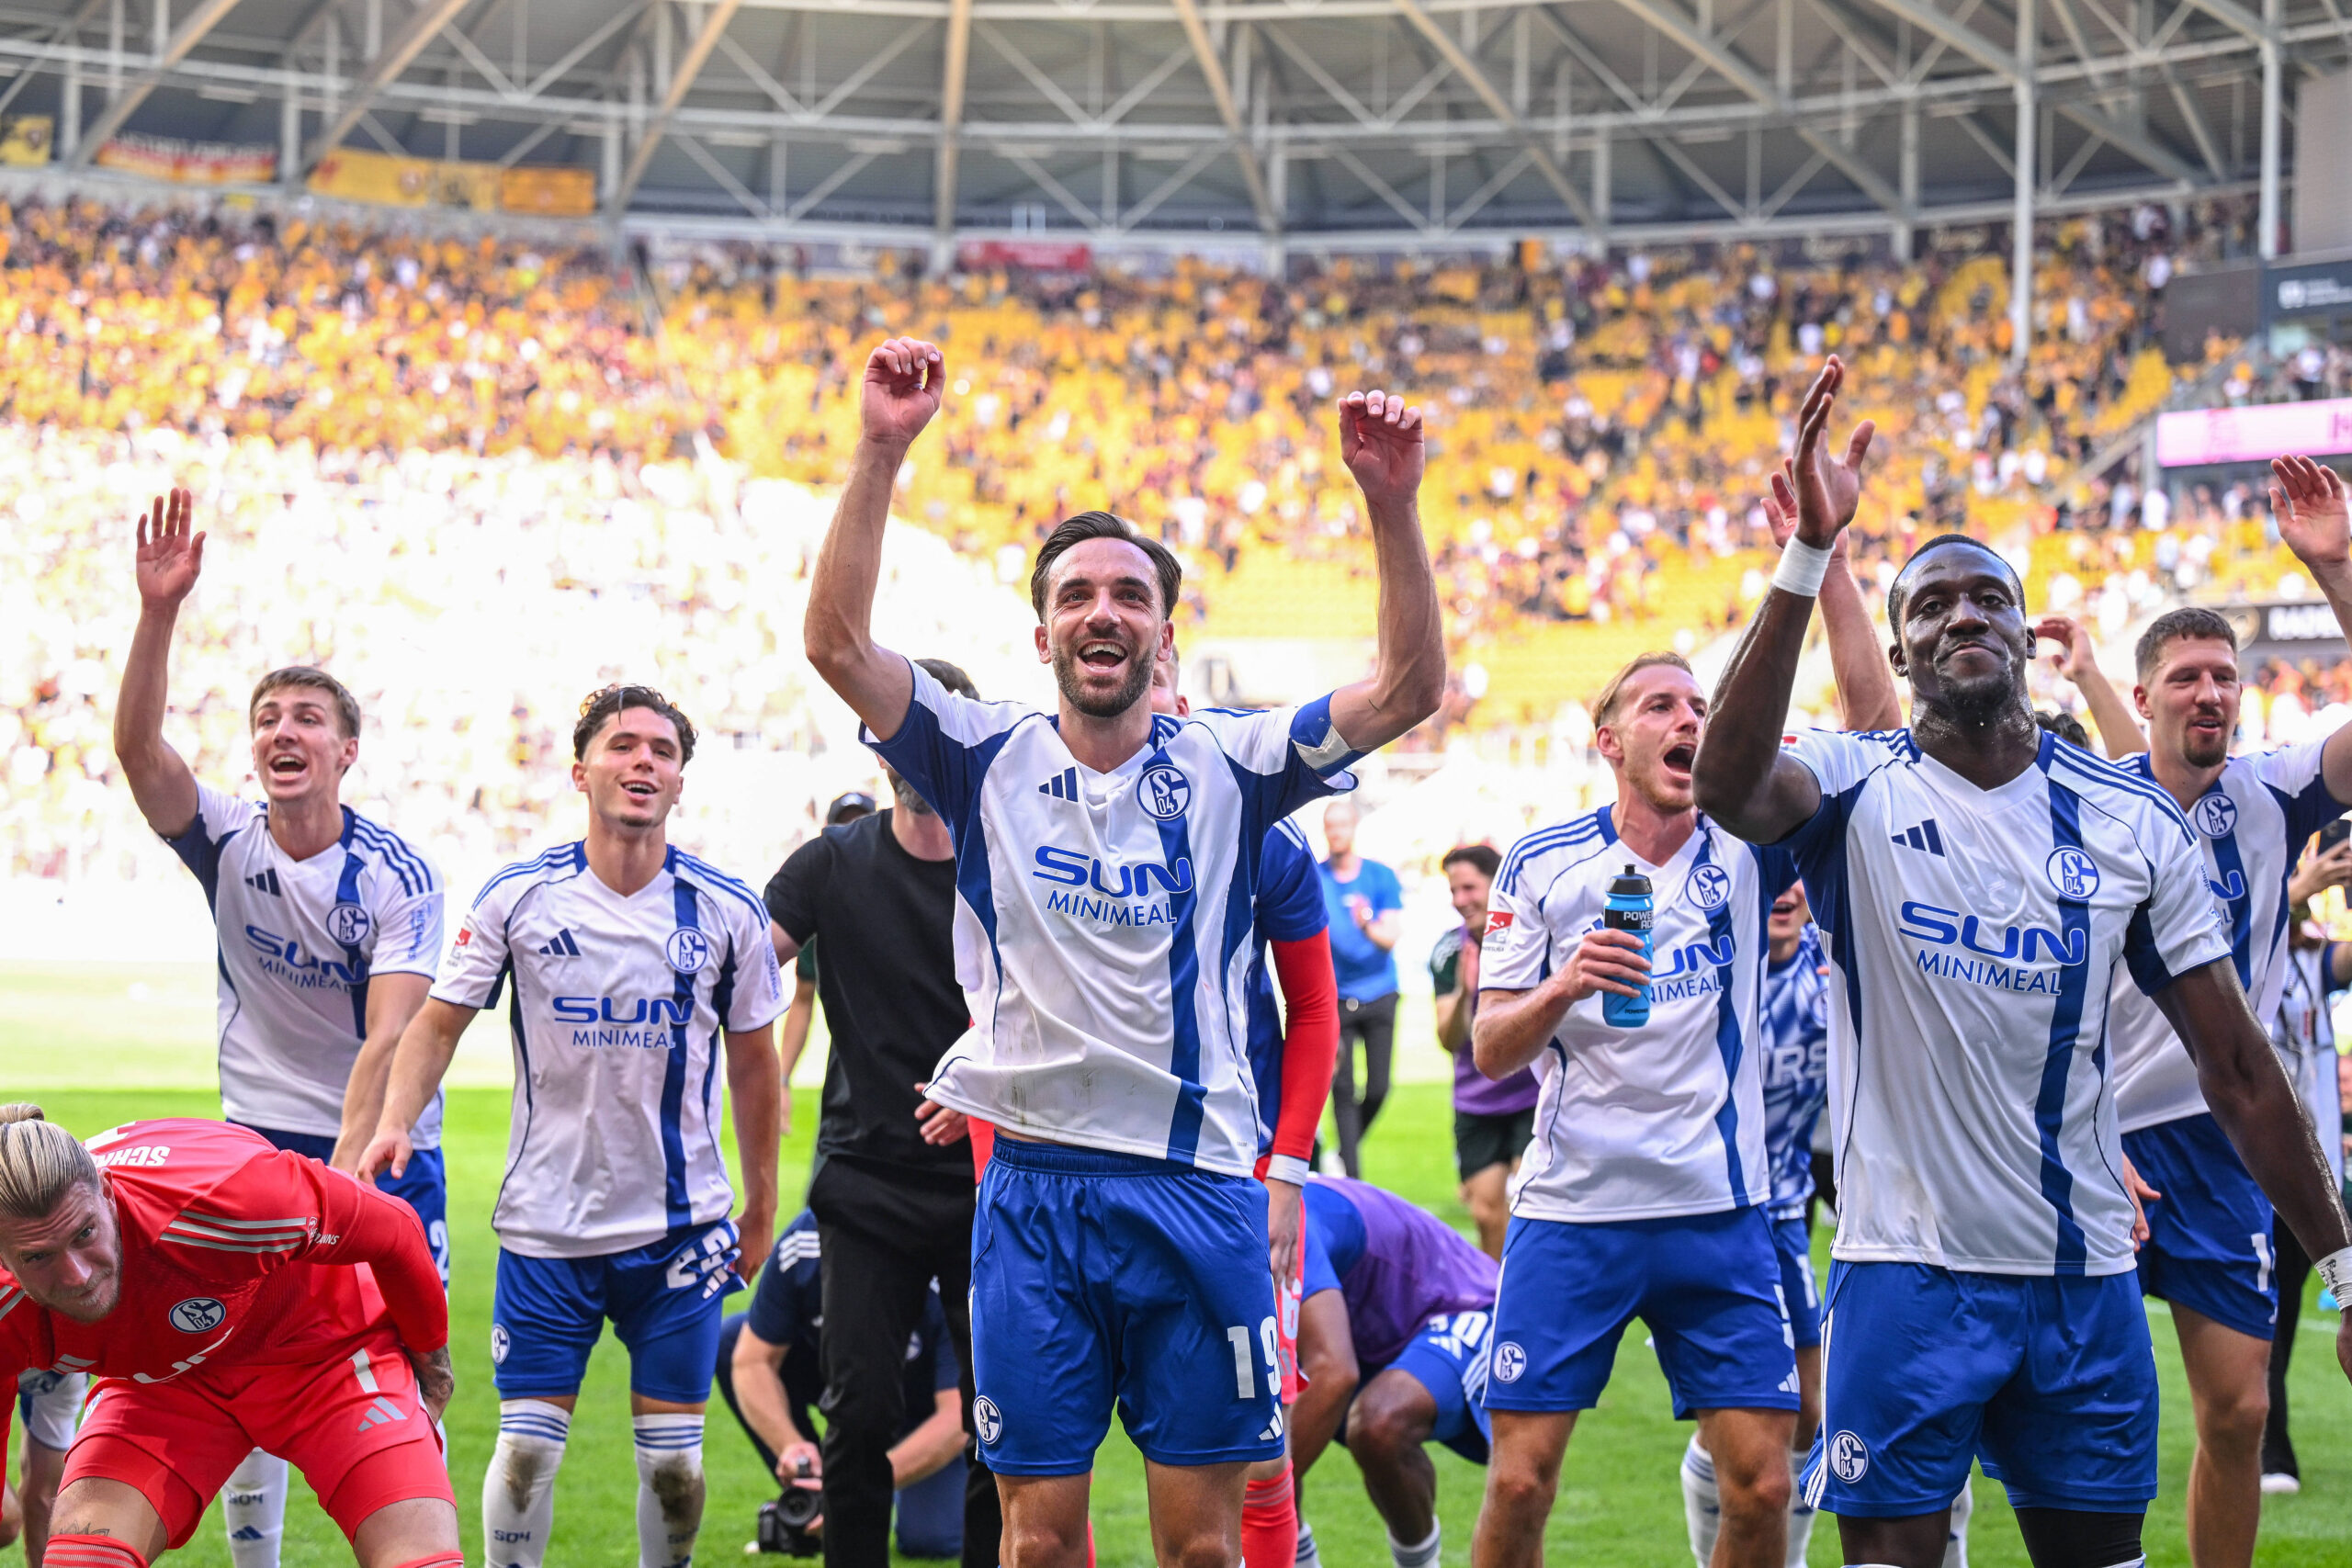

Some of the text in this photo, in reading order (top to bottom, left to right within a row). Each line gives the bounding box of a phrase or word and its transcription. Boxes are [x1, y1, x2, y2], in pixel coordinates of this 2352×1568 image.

[1032, 844, 1194, 899] SUN
[1046, 889, 1178, 928] MINIMEAL
[245, 924, 368, 985] SUN
[1651, 934, 1735, 978] UN
[1898, 900, 2086, 966] SUN
[1917, 949, 2063, 997] MINIMEAL
[552, 997, 695, 1025] SUN
[572, 1029, 677, 1049] MINIMEAL
[1227, 1315, 1282, 1399] 19
